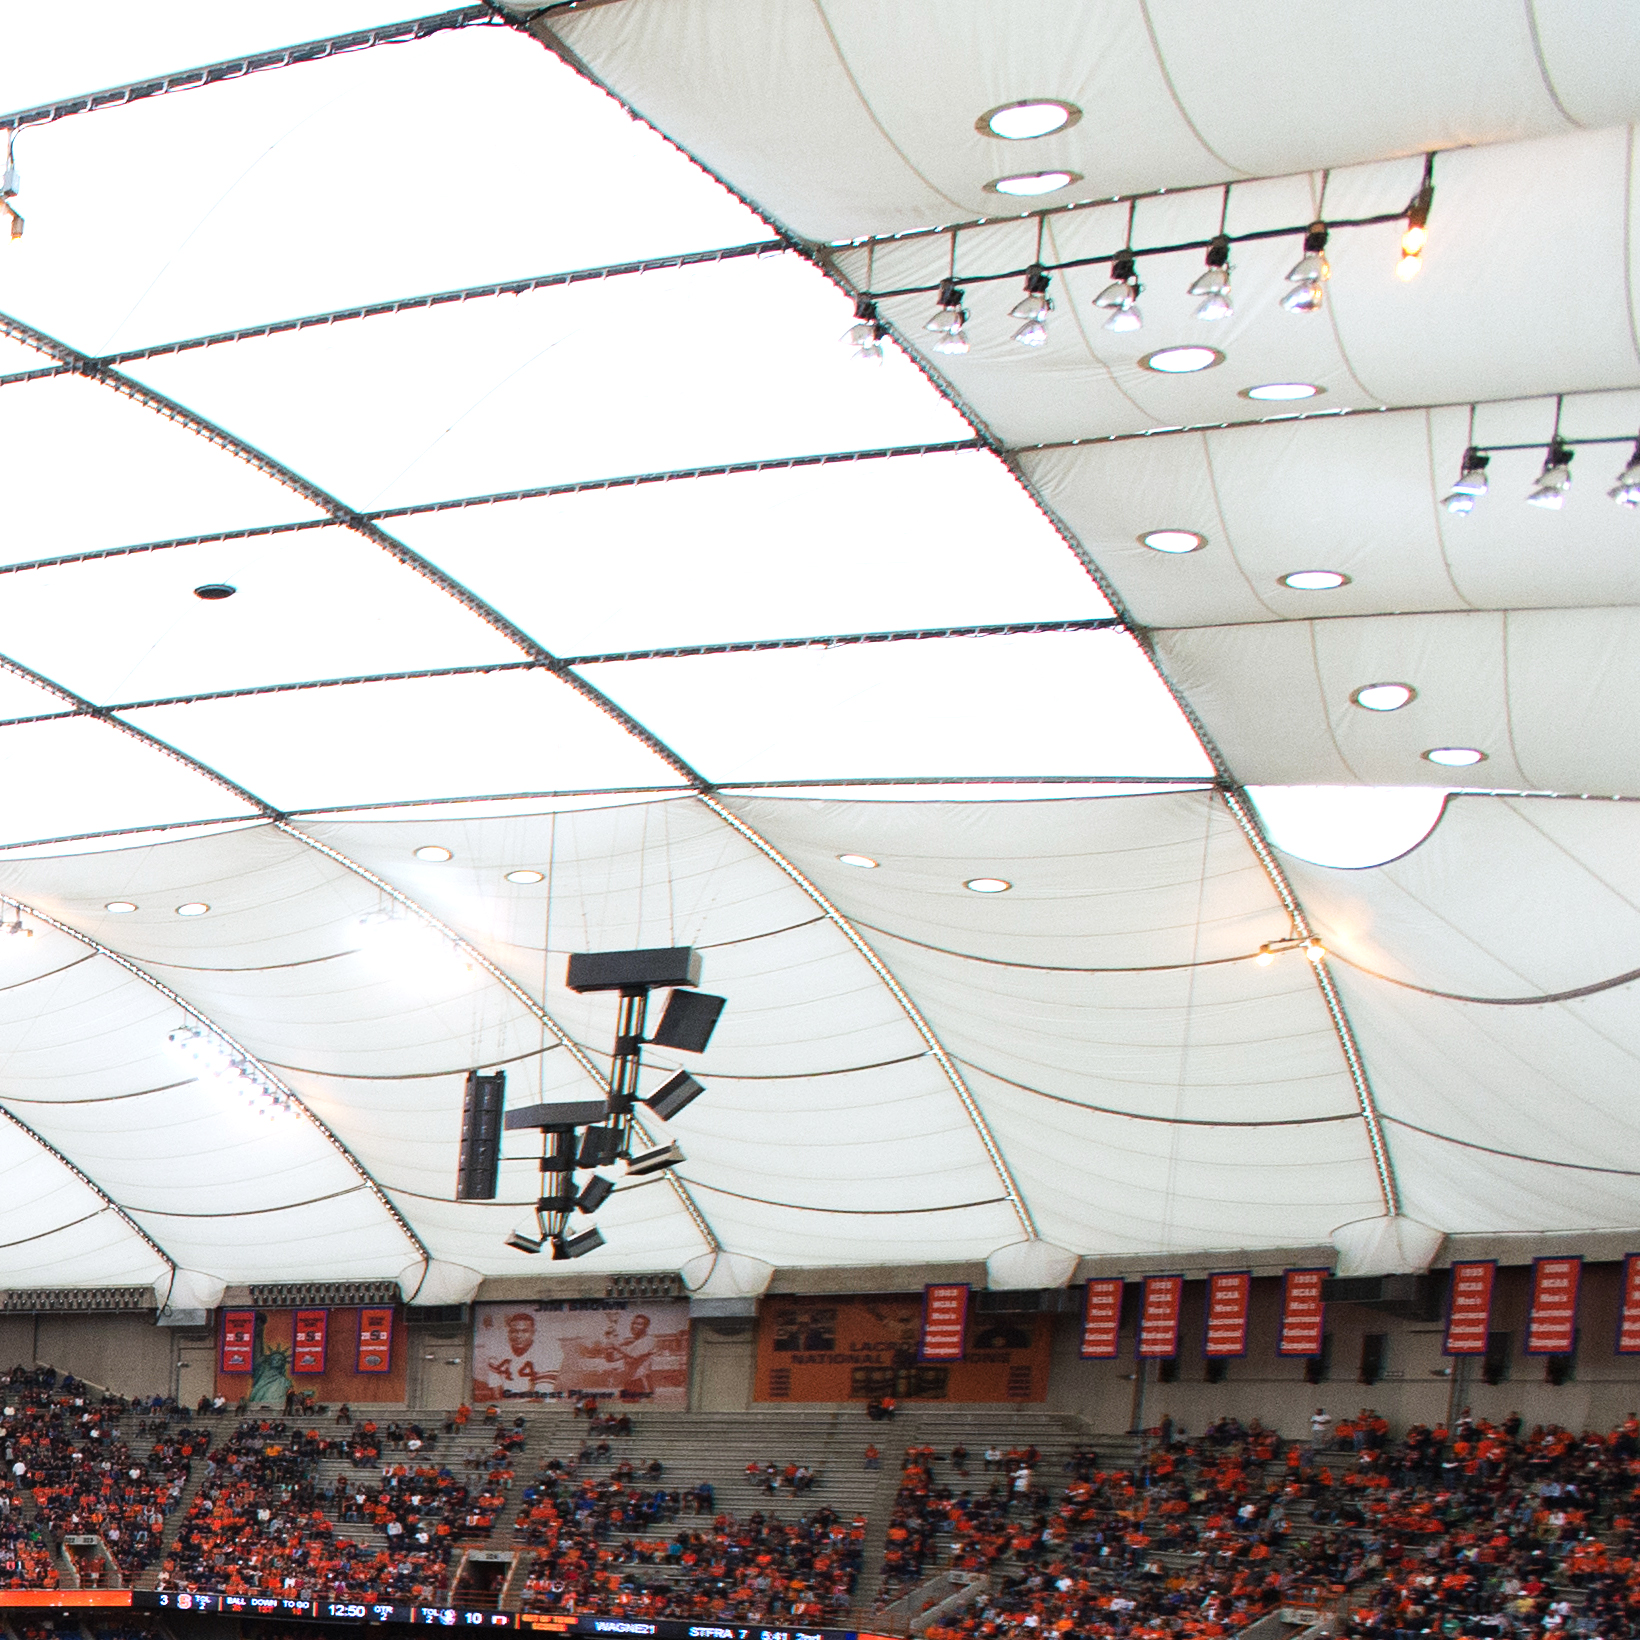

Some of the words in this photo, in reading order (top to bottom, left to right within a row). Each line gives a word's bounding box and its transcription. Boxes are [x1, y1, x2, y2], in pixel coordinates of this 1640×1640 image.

[159, 1594, 168, 1606] 3
[328, 1604, 366, 1618] 12:50
[464, 1612, 482, 1624] 10
[688, 1626, 734, 1639] STFRA
[738, 1630, 748, 1640] 7
